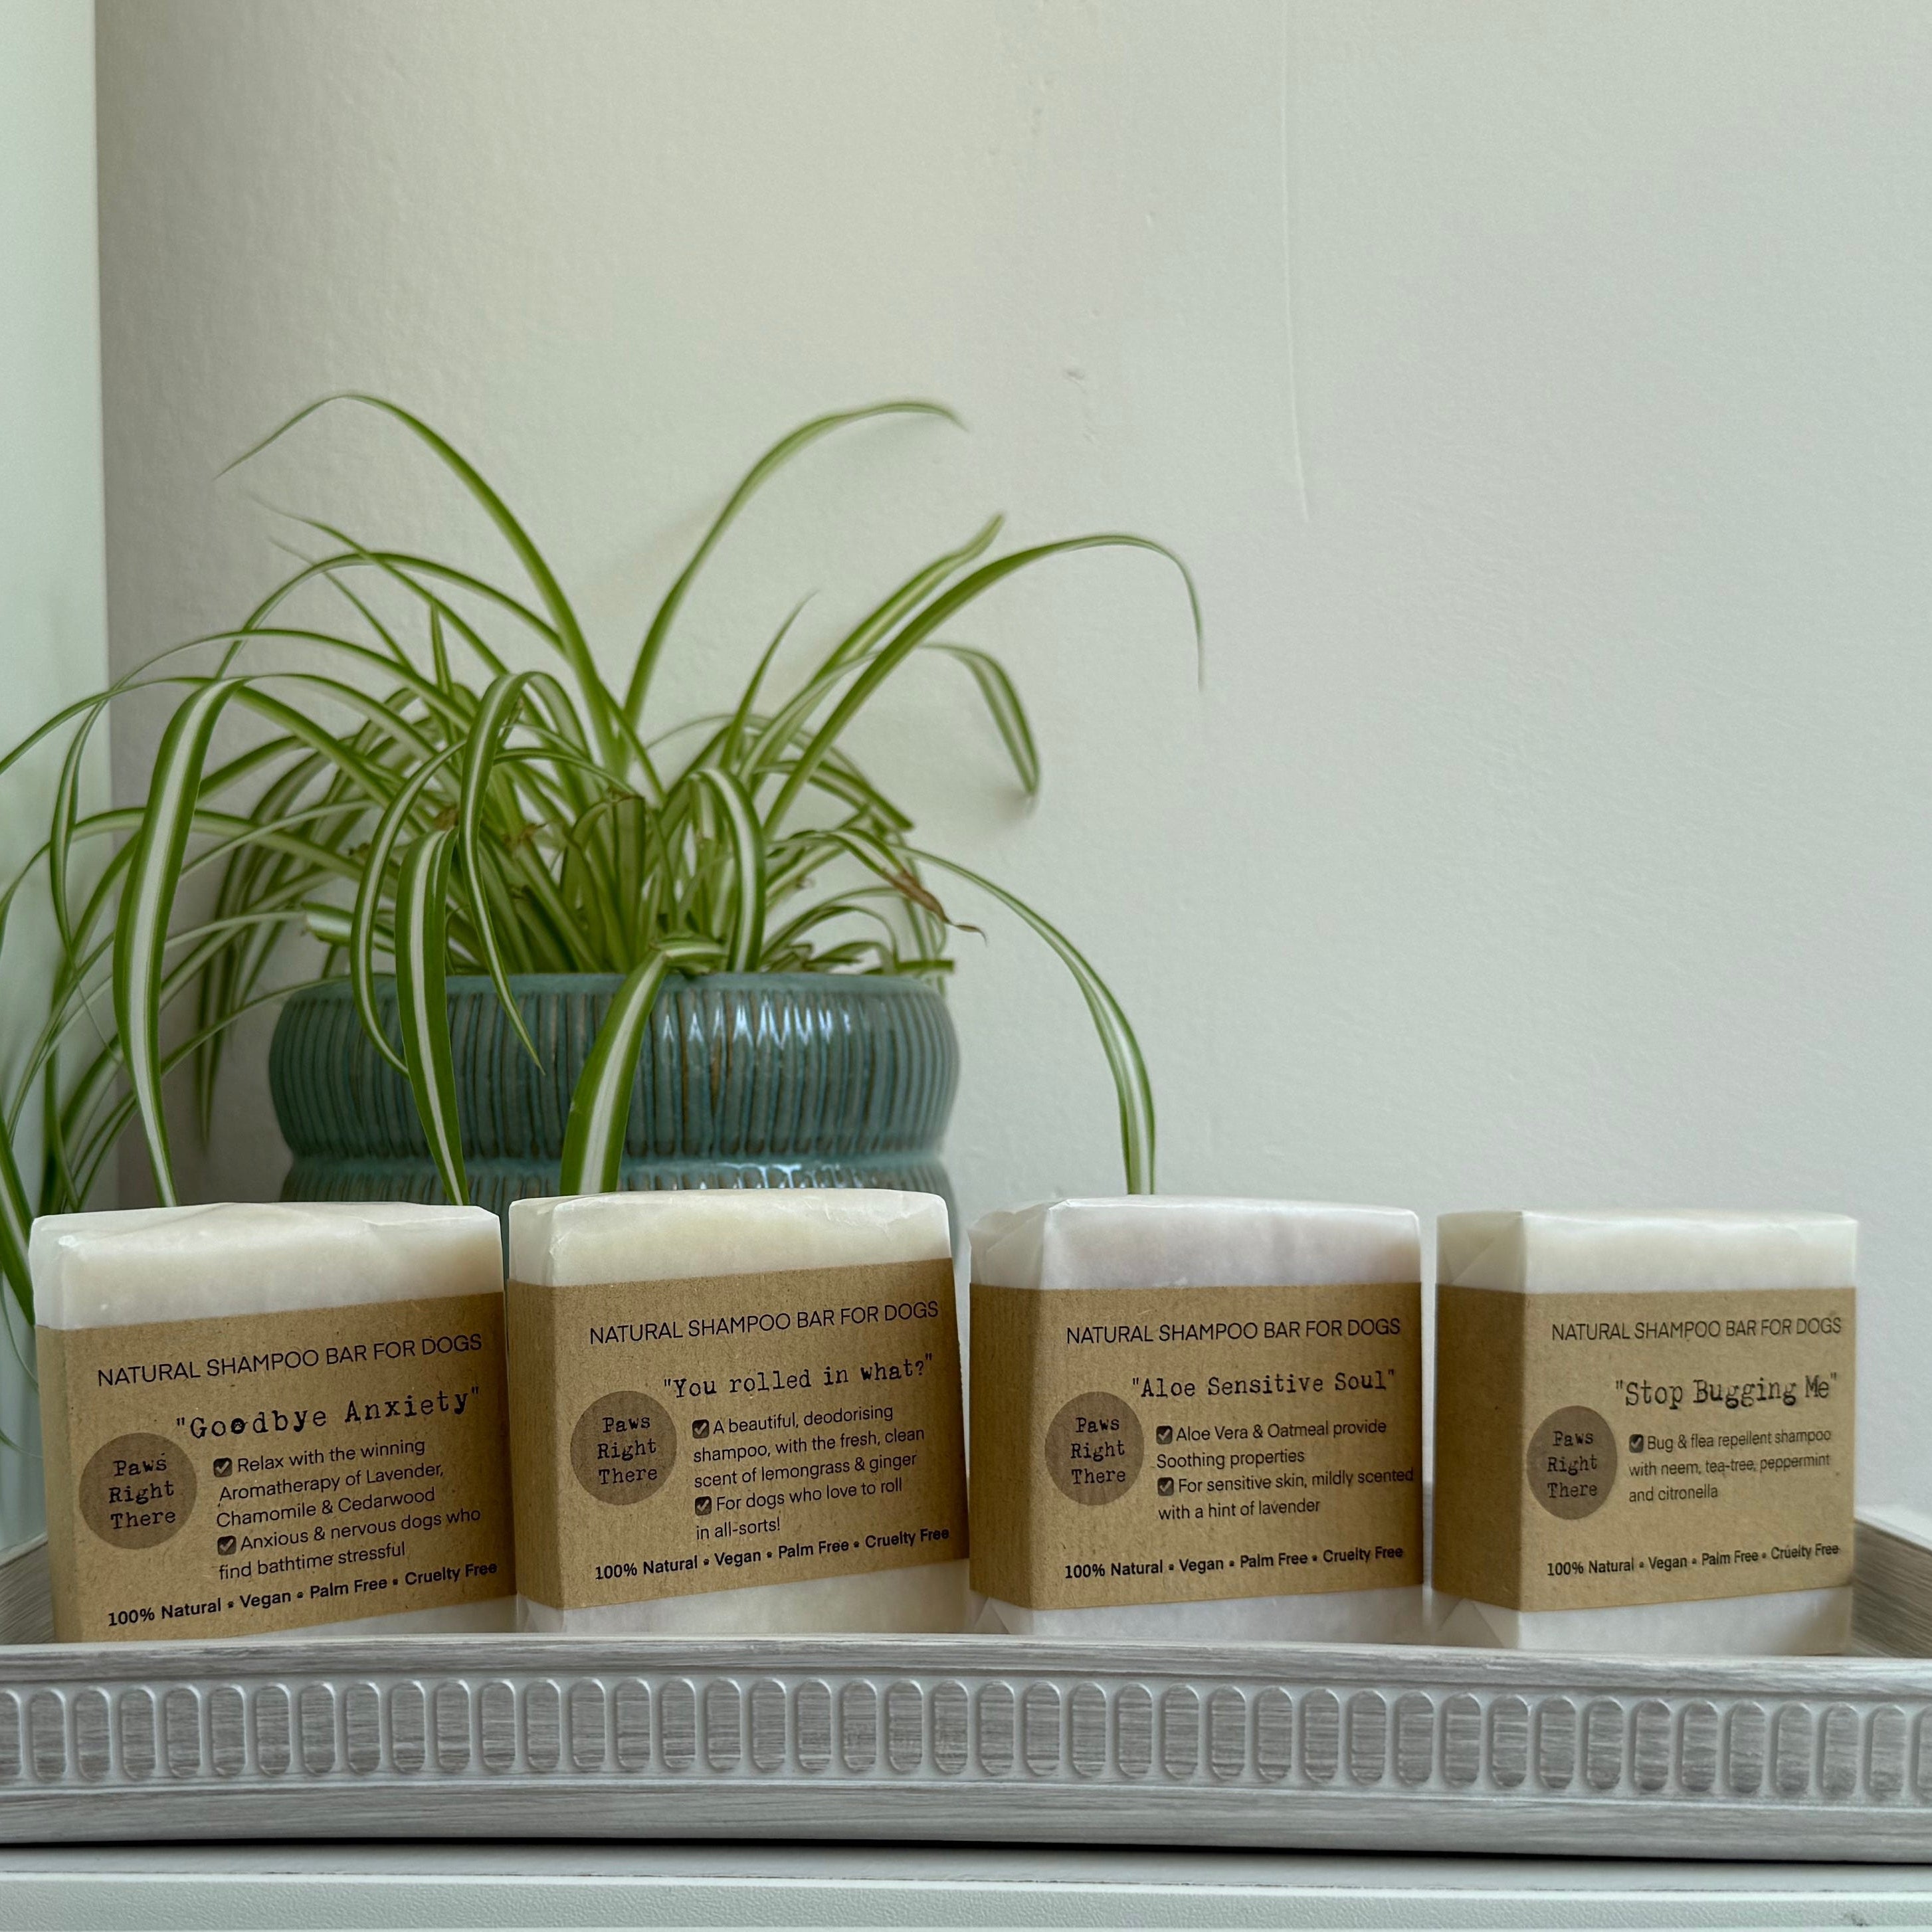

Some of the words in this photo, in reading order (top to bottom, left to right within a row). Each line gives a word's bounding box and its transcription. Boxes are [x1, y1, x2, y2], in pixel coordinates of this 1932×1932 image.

[591, 1321, 683, 1344] NATURAL
[689, 1313, 791, 1337] SHAMPOO
[798, 1309, 834, 1328] BAR
[841, 1306, 878, 1325] FOR
[885, 1300, 939, 1321] DOGS
[1068, 1325, 1153, 1344] NATURAL
[1159, 1322, 1258, 1341] SHAMPOO
[1264, 1321, 1300, 1338] BAR
[1306, 1320, 1342, 1337] FOR
[1347, 1318, 1401, 1336] DOGS
[1553, 1323, 1630, 1340] NATURAL
[1634, 1321, 1721, 1339] SHAMPOO
[1726, 1319, 1757, 1337] BAR
[1761, 1319, 1792, 1335] FOR
[1796, 1317, 1842, 1334] DOGS
[98, 1362, 201, 1387] NATURAL
[207, 1349, 319, 1377] SHAMPOO
[326, 1345, 367, 1365] BAR
[374, 1340, 415, 1360] FOR
[422, 1333, 482, 1355] DOGS
[664, 1379, 717, 1398] "You
[729, 1369, 811, 1393] rolled
[824, 1367, 848, 1386] in
[861, 1352, 933, 1381] what?"
[1133, 1377, 1195, 1398] "Aloe
[1208, 1374, 1323, 1395] Sensitive
[1335, 1369, 1397, 1391] Soul"
[1616, 1380, 1683, 1410] "Stop
[1693, 1377, 1797, 1409] Bugging
[1805, 1373, 1836, 1399] Me"
[177, 1410, 326, 1438] "Goodbye
[345, 1386, 480, 1423] Anxiety"
[603, 1417, 650, 1433] Paws
[714, 1420, 724, 1434] A
[729, 1412, 799, 1432] beautiful,
[804, 1405, 893, 1426] deodorising
[1076, 1417, 1119, 1433] Paws
[1176, 1426, 1210, 1441] Aloe
[1214, 1426, 1248, 1440] Vera
[1253, 1424, 1263, 1438] &
[1268, 1420, 1329, 1438] Oatmeal
[1333, 1418, 1388, 1438] provide
[1553, 1430, 1593, 1446] Paws
[1648, 1436, 1674, 1453] Bug
[1678, 1434, 1687, 1449] &
[1691, 1434, 1714, 1448] flea
[1718, 1431, 1772, 1450] repellent
[1775, 1429, 1832, 1445] shampoo
[238, 1456, 284, 1472] Relax
[289, 1449, 324, 1466] with
[329, 1447, 355, 1462] the
[361, 1440, 425, 1458] winning
[597, 1438, 656, 1461] Right
[694, 1446, 770, 1462] shampoo,
[775, 1438, 807, 1454] with
[812, 1436, 835, 1450] the
[840, 1430, 880, 1448] fresh,
[885, 1428, 924, 1443] clean
[1071, 1440, 1125, 1462] Right
[113, 1459, 167, 1476] Paws
[695, 1471, 737, 1488] scent
[742, 1468, 757, 1483] of
[762, 1462, 850, 1481] lemongrass
[854, 1457, 865, 1472] &
[870, 1450, 918, 1473] ginger
[1157, 1452, 1225, 1470] Soothing
[1230, 1448, 1305, 1469] properties
[1547, 1454, 1597, 1476] Right
[1629, 1462, 1657, 1476] with
[1661, 1463, 1701, 1475] neem,
[1705, 1457, 1757, 1475] tea-tree,
[1760, 1452, 1830, 1472] peppermint
[219, 1476, 339, 1501] Aromatherapy
[345, 1470, 361, 1486] of
[367, 1463, 444, 1484] Lavender,
[599, 1468, 657, 1485] There
[1072, 1468, 1125, 1484] There
[1179, 1478, 1203, 1492] For
[1207, 1477, 1272, 1492] sensitive
[1276, 1473, 1307, 1488] skin,
[1312, 1470, 1354, 1488] mildly
[1358, 1466, 1413, 1484] scented
[109, 1480, 174, 1505] Right
[717, 1496, 741, 1511] For
[746, 1493, 785, 1509] dogs
[789, 1488, 822, 1503] who
[827, 1485, 856, 1499] love
[861, 1483, 876, 1495] to
[881, 1477, 902, 1493] roll
[1547, 1482, 1597, 1498] There
[1629, 1486, 1654, 1502] and
[1658, 1484, 1718, 1501] citronella
[217, 1502, 316, 1527] Chamomile
[322, 1500, 333, 1514] &
[338, 1486, 435, 1512] Cedarwood
[1159, 1505, 1190, 1520] with
[1195, 1507, 1203, 1519] a
[1208, 1503, 1236, 1517] hint
[1240, 1501, 1254, 1516] of
[1259, 1497, 1321, 1515] lavender
[110, 1511, 175, 1529] There
[241, 1532, 308, 1551] Anxious
[314, 1527, 325, 1541] &
[332, 1521, 396, 1539] nervous
[401, 1515, 441, 1531] dogs
[446, 1508, 481, 1523] who
[696, 1525, 709, 1540] in
[715, 1516, 780, 1537] all-sorts!
[219, 1561, 251, 1580] find
[258, 1555, 334, 1575] bathtime
[338, 1541, 405, 1564] stressful
[596, 1563, 637, 1580] 100%
[643, 1555, 697, 1575] Natural
[714, 1551, 761, 1567] Vegan
[779, 1543, 813, 1559] Palm
[819, 1541, 849, 1554] Free
[866, 1531, 916, 1548] Cruelty
[920, 1529, 949, 1543] Free
[1066, 1564, 1105, 1579] 100%
[1111, 1559, 1163, 1576] Natural
[1179, 1559, 1224, 1574] Vegan
[1240, 1554, 1274, 1568] Palm
[1279, 1553, 1308, 1565] Free
[1323, 1547, 1373, 1563] Cruelty
[1375, 1546, 1404, 1559] Free
[1548, 1562, 1584, 1576] 100%
[1589, 1557, 1634, 1573] Natural
[1648, 1557, 1688, 1572] Vegan
[1702, 1552, 1731, 1565] Palm
[1734, 1550, 1759, 1563] Free
[1771, 1545, 1812, 1560] Cruelty
[1815, 1543, 1840, 1556] Free
[108, 1608, 155, 1626] 100%
[161, 1598, 221, 1619] Natural
[240, 1593, 291, 1608] Vegan
[310, 1583, 348, 1598] Palm
[355, 1579, 387, 1593] Free
[405, 1567, 460, 1585] Cruelty
[466, 1563, 498, 1577] Free
